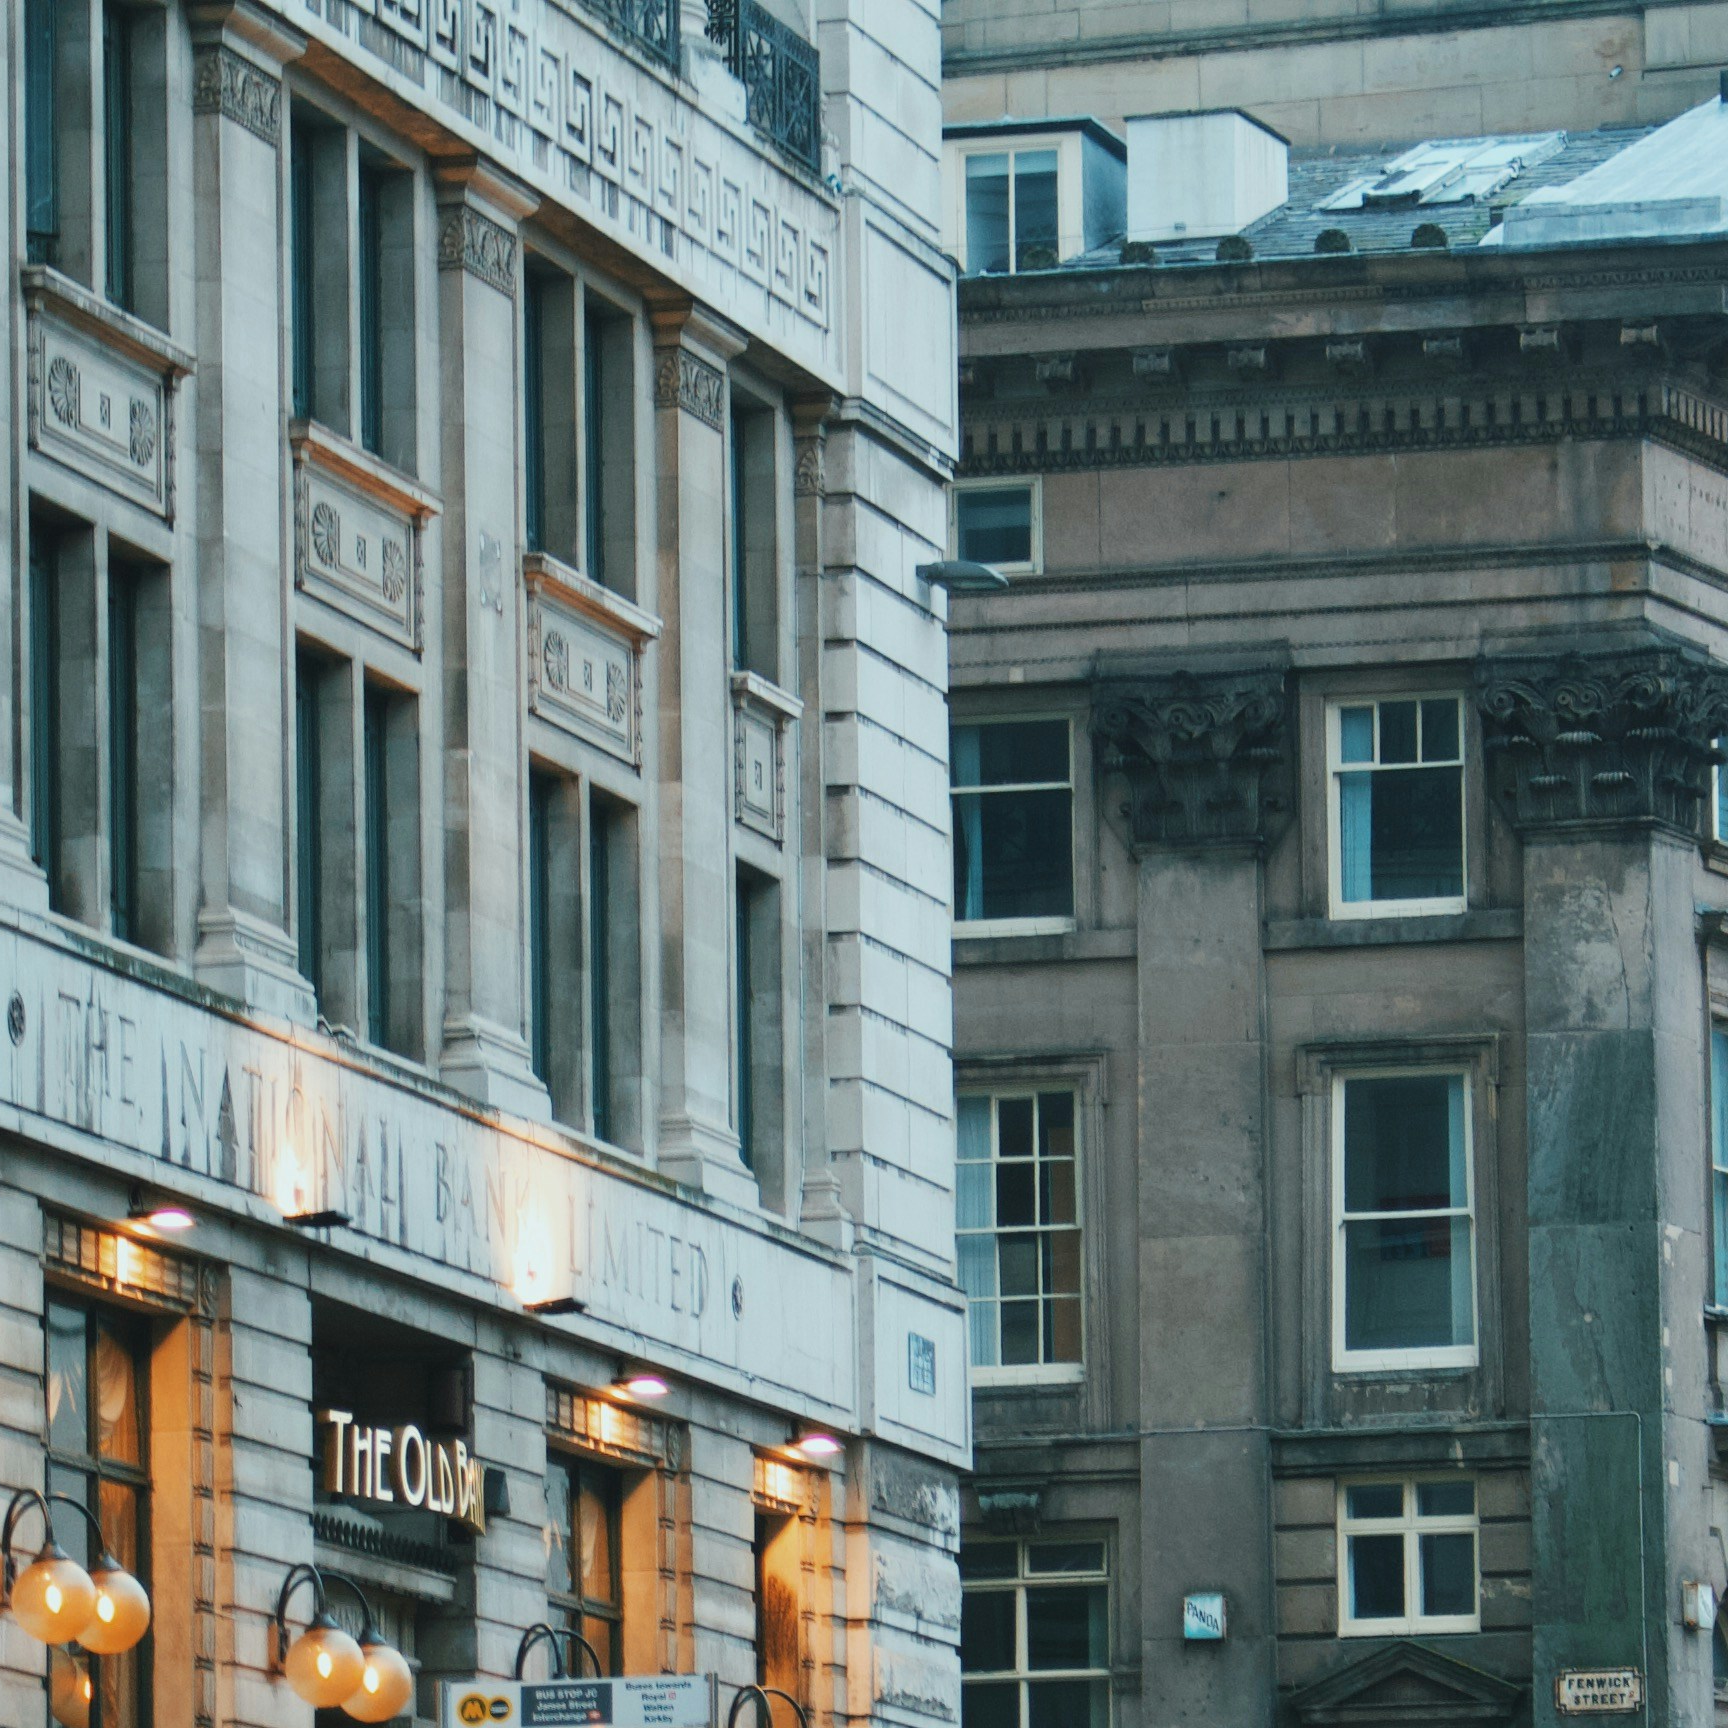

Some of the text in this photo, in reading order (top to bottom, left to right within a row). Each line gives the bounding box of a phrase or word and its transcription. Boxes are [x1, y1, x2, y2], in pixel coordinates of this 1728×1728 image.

[58, 990, 137, 1107] THE
[567, 1194, 709, 1318] LIMITED
[327, 1409, 393, 1503] THE
[399, 1424, 454, 1515] OLD
[1187, 1601, 1219, 1631] PANDA
[625, 1681, 691, 1691] Buses towards
[1568, 1677, 1630, 1690] FENWICK
[535, 1689, 555, 1699] BUS
[558, 1688, 583, 1699] STOP
[642, 1693, 666, 1702] Royal
[1574, 1693, 1627, 1706] STREET
[537, 1700, 597, 1711] James Street
[533, 1712, 587, 1723] Interchange
[644, 1715, 672, 1723] Kirkby
